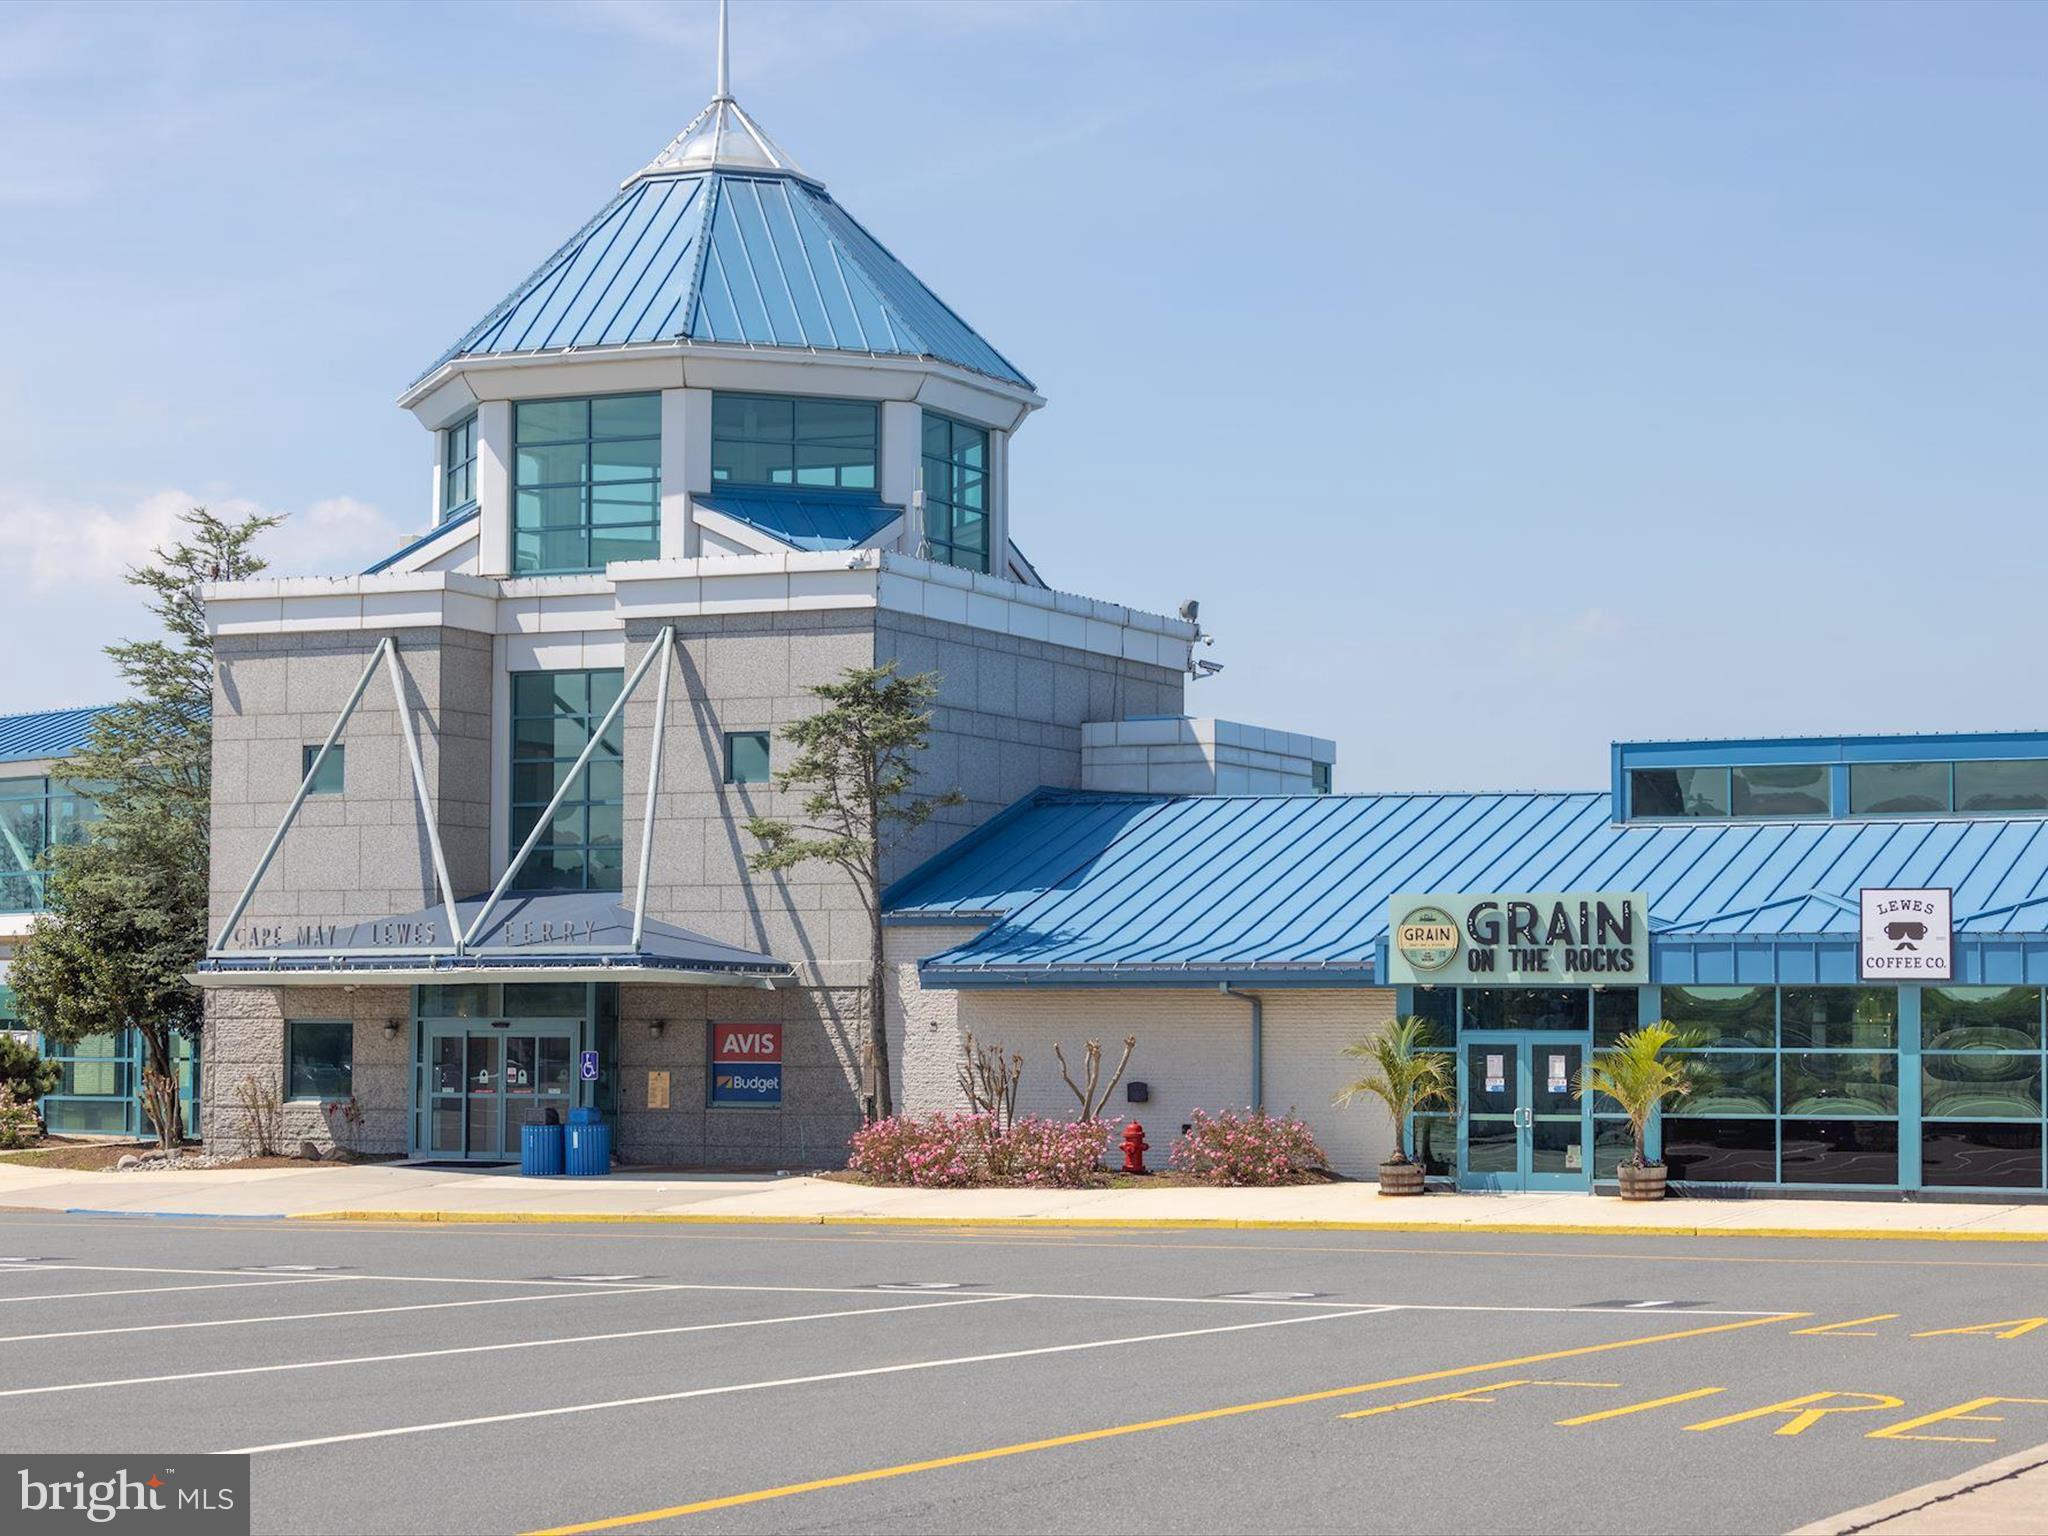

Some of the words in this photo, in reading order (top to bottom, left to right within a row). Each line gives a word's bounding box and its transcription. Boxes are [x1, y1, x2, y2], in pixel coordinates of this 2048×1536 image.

[1876, 899, 1935, 916] LEWES
[234, 925, 282, 949] CAPE
[297, 924, 337, 947] MAY
[371, 922, 436, 946] LEWES
[504, 919, 596, 944] FERRY
[1404, 927, 1451, 942] GRAIN
[1466, 900, 1633, 946] GRAIN
[1467, 948, 1495, 973] ON
[1508, 948, 1550, 973] THE
[1565, 947, 1635, 973] ROCKS
[1866, 956, 1922, 970] COFFEE
[1924, 956, 1947, 970] CO.
[722, 1032, 775, 1055] AVIS
[733, 1075, 779, 1093] Budget
[1335, 1379, 2048, 1443] FIRE
